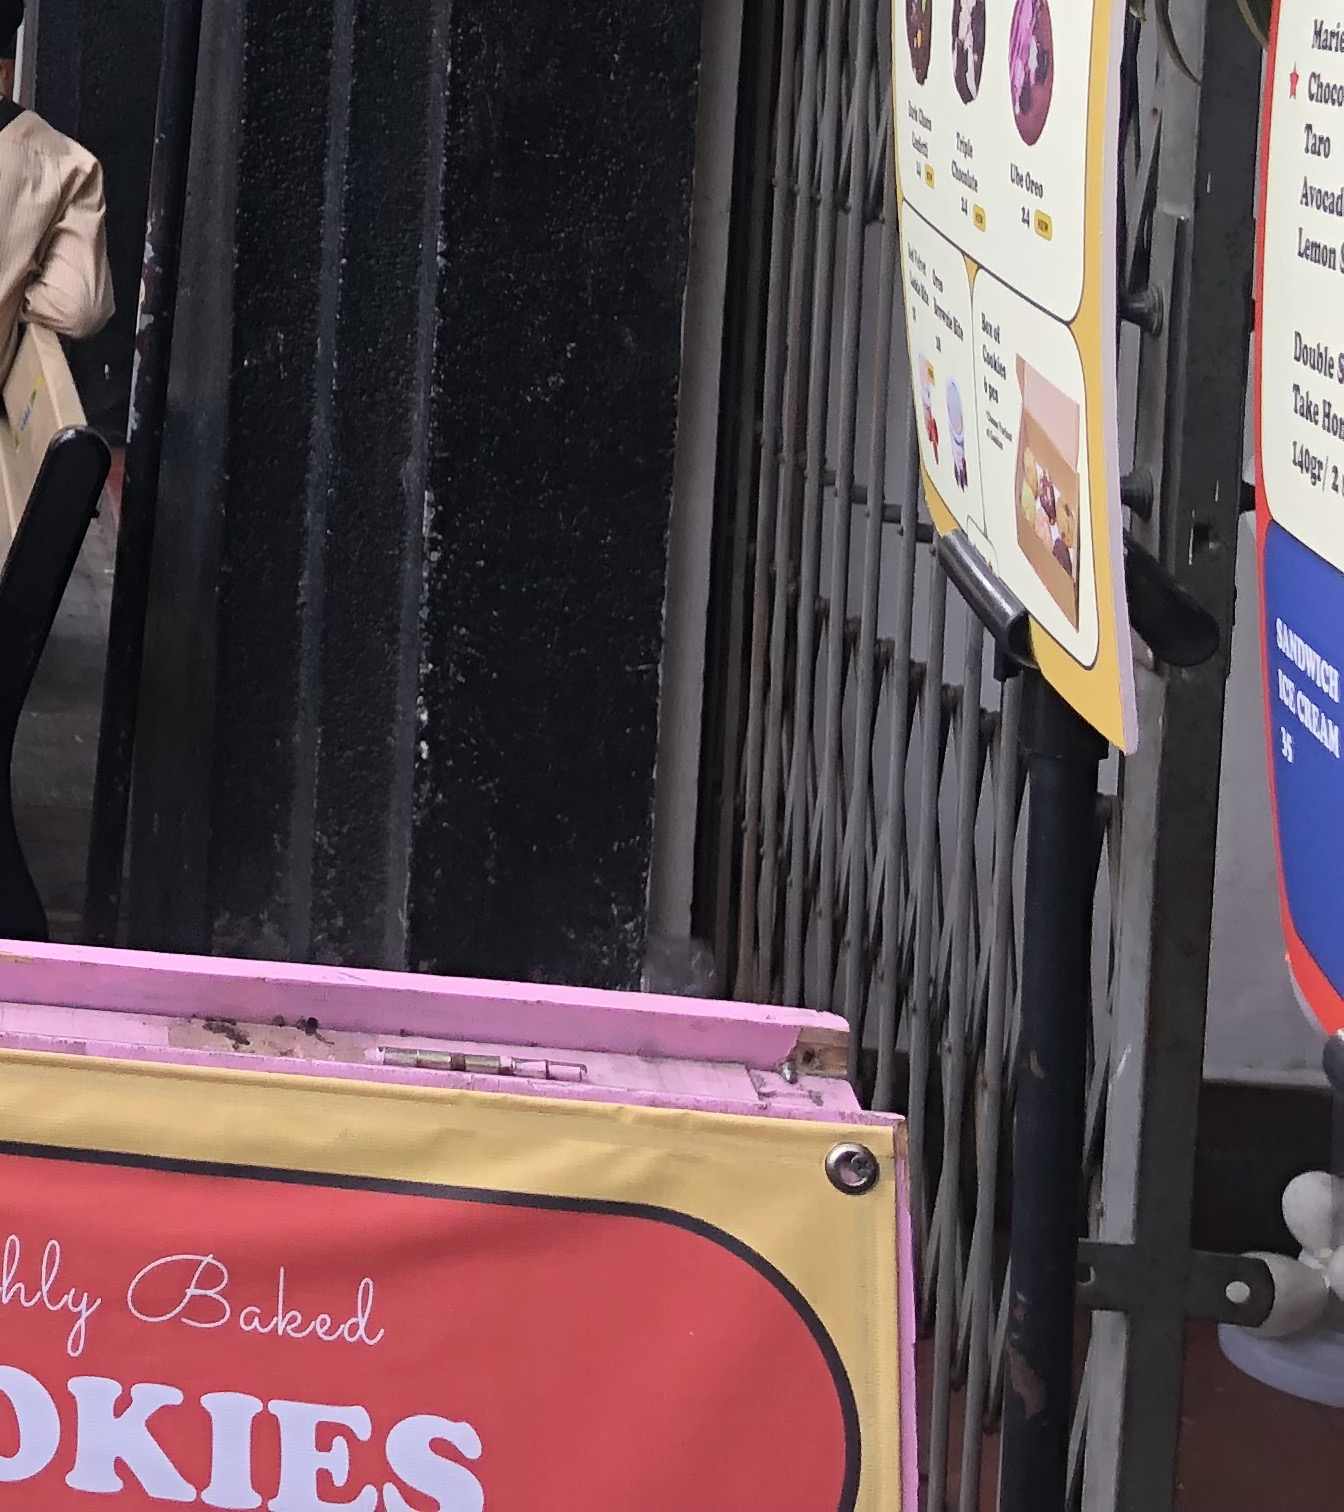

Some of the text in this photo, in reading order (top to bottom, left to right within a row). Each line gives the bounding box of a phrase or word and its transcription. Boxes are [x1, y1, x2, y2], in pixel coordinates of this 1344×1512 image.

[1304, 123, 1331, 159] Taro
[1010, 162, 1044, 199] Ube Oreo
[1297, 226, 1336, 272] Lemon
[1293, 330, 1334, 379] Double
[1292, 382, 1319, 426] Take
[1276, 617, 1340, 704] SANDWICH
[1277, 668, 1340, 759] ICE CREAM
[127, 1253, 386, 1346] Baked
